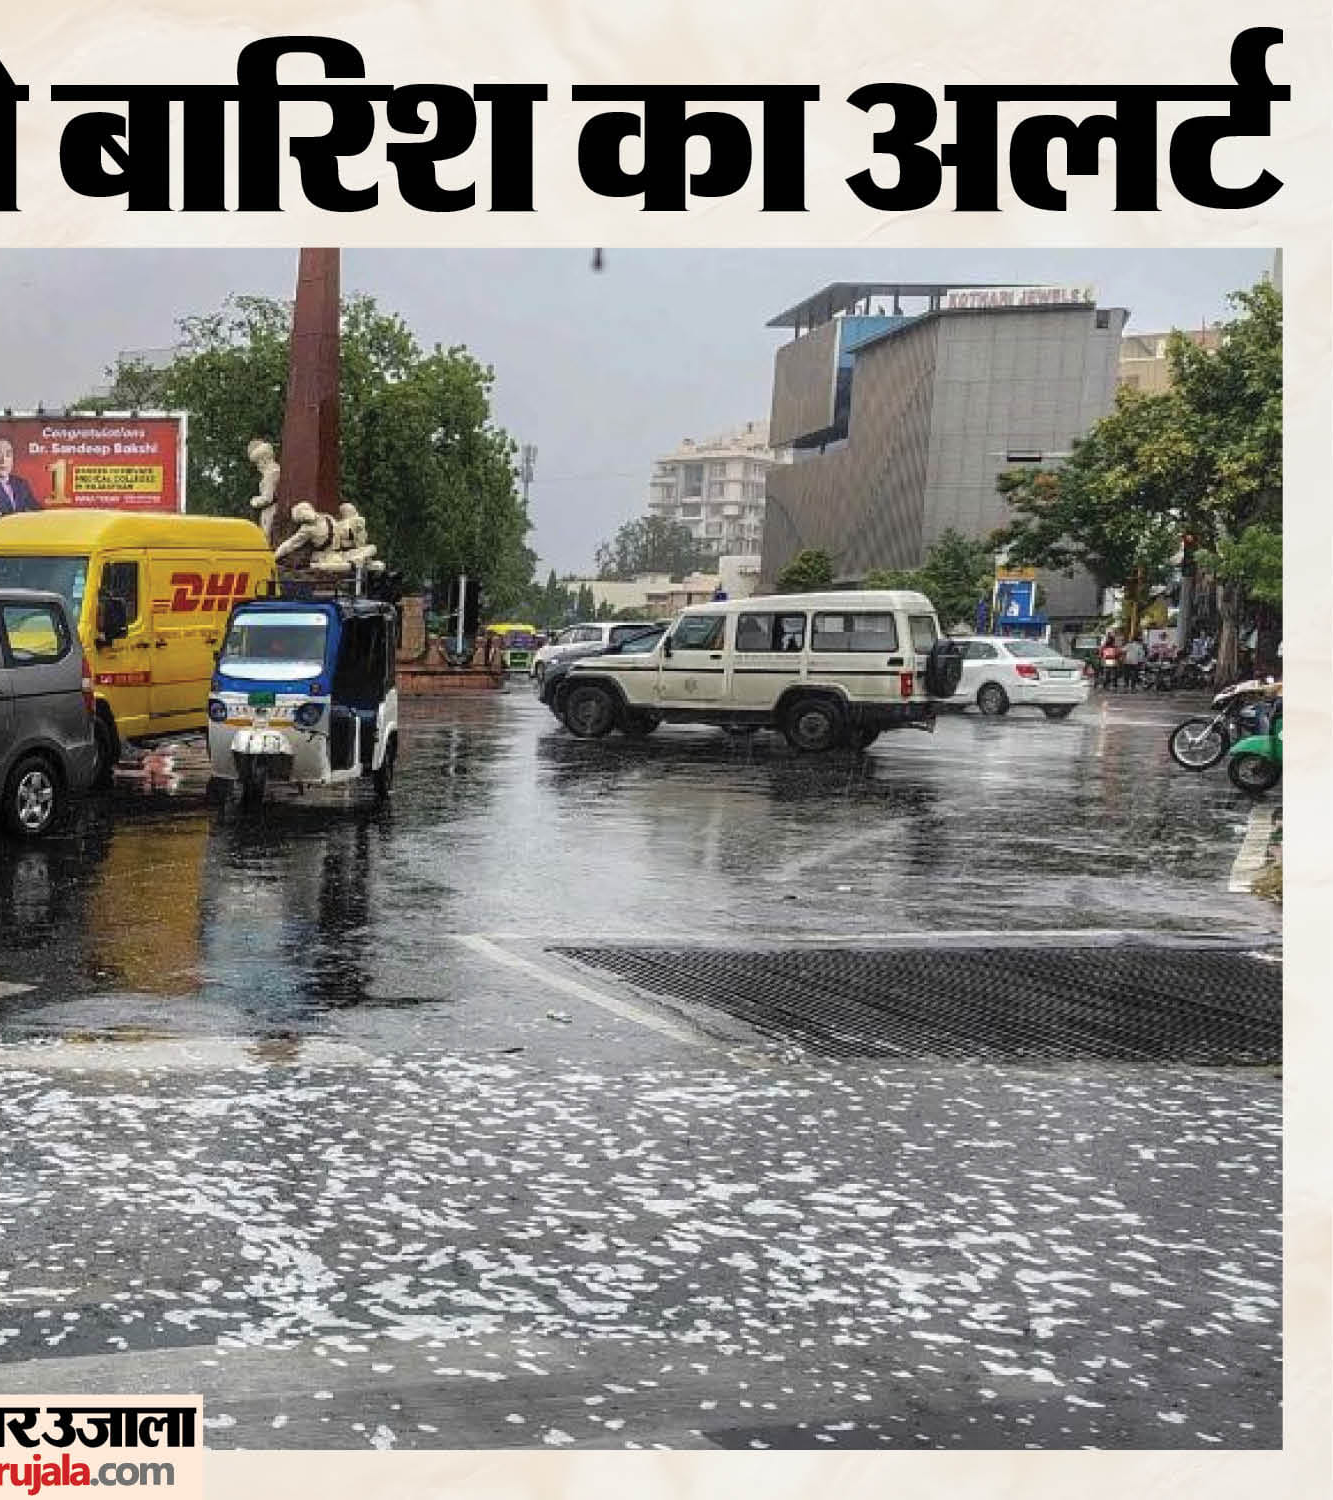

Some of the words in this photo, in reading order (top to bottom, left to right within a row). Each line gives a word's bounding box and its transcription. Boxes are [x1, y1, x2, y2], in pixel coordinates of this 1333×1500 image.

[42, 427, 145, 440] Congratulations
[28, 442, 49, 454] Dr.
[51, 442, 111, 456] Sandeep
[113, 442, 159, 454] Bakshi
[171, 571, 251, 612] DHL
